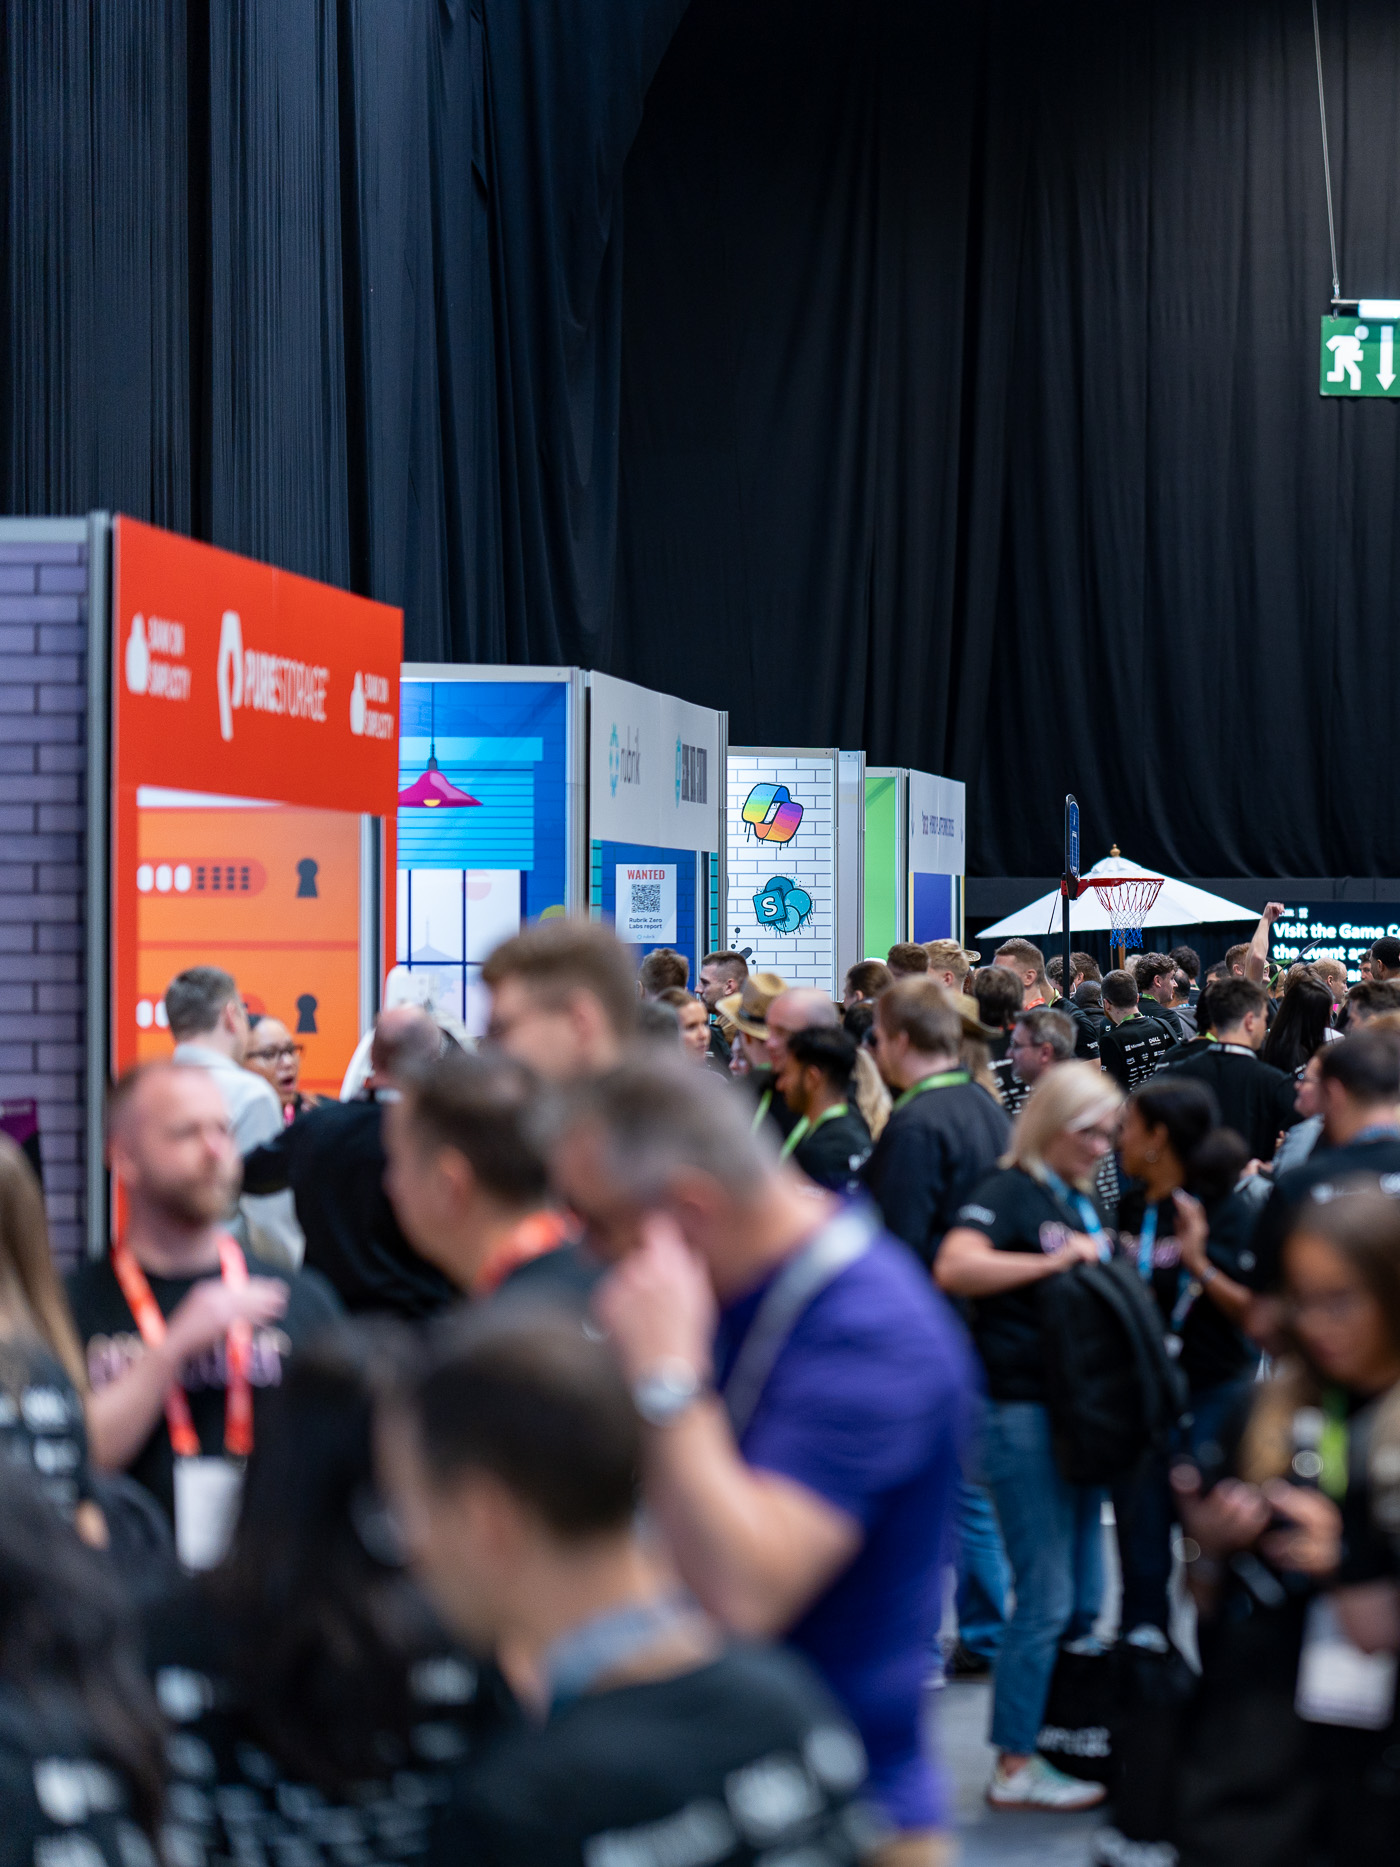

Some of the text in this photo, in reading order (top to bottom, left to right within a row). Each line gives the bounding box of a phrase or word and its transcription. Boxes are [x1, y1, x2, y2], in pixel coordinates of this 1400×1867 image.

[627, 869, 665, 880] WANTED
[1273, 922, 1308, 938] Visit
[1310, 922, 1337, 938] the
[1339, 923, 1385, 939] Game
[1273, 943, 1300, 960] the
